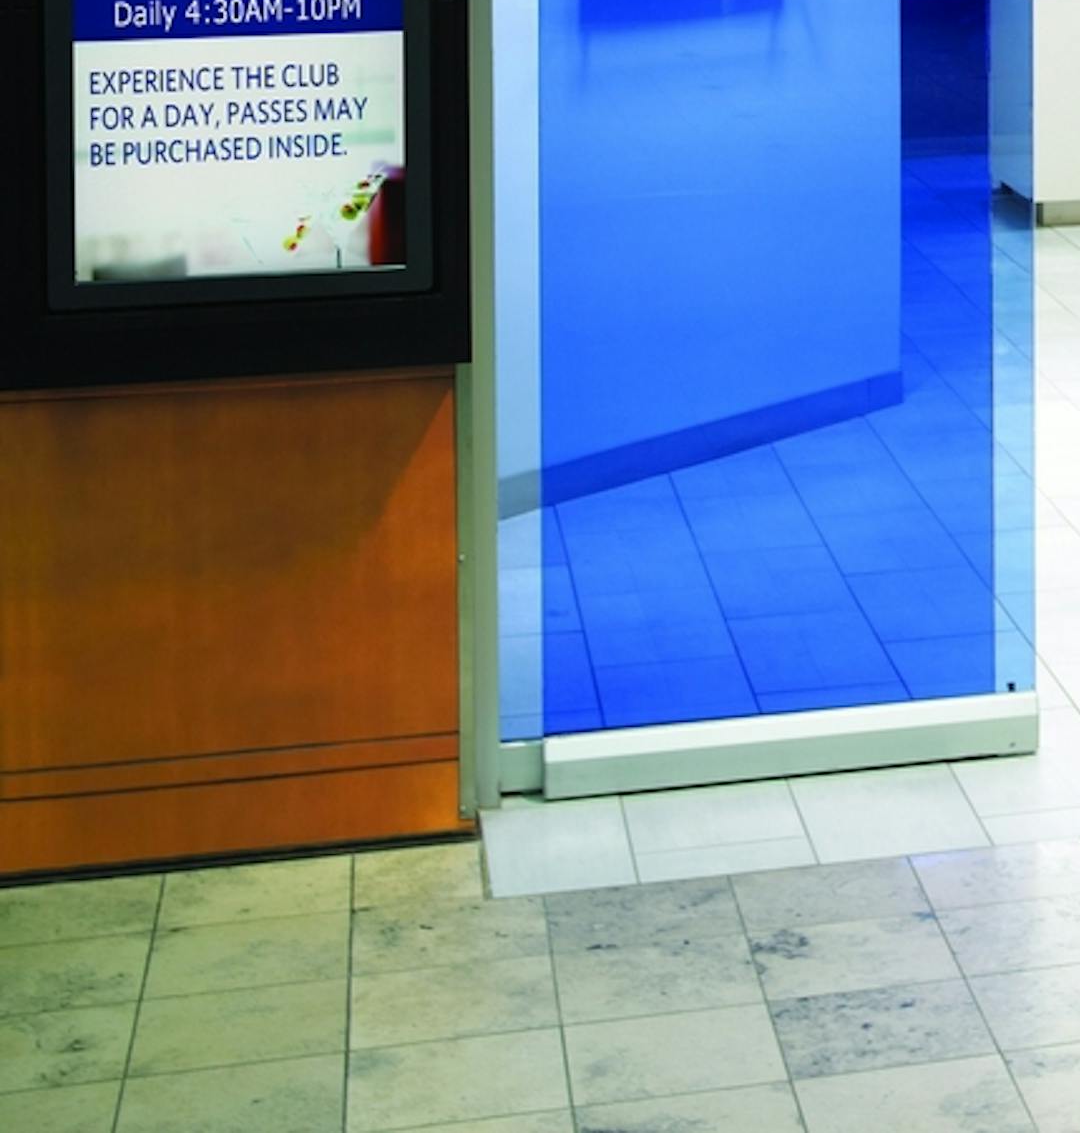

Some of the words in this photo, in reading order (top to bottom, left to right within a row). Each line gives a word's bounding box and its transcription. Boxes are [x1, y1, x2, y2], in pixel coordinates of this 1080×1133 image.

[89, 67, 224, 95] EXPERIENCE
[230, 65, 275, 89] THE
[282, 63, 340, 88] CLUB
[90, 105, 134, 130] FOR
[140, 104, 157, 128] A
[165, 102, 221, 129] DAY,
[227, 99, 307, 125] PASSES
[314, 97, 368, 122] MAY
[90, 142, 116, 166] BE
[122, 136, 262, 165] PURCHASED
[268, 133, 347, 159] INSIDE.
